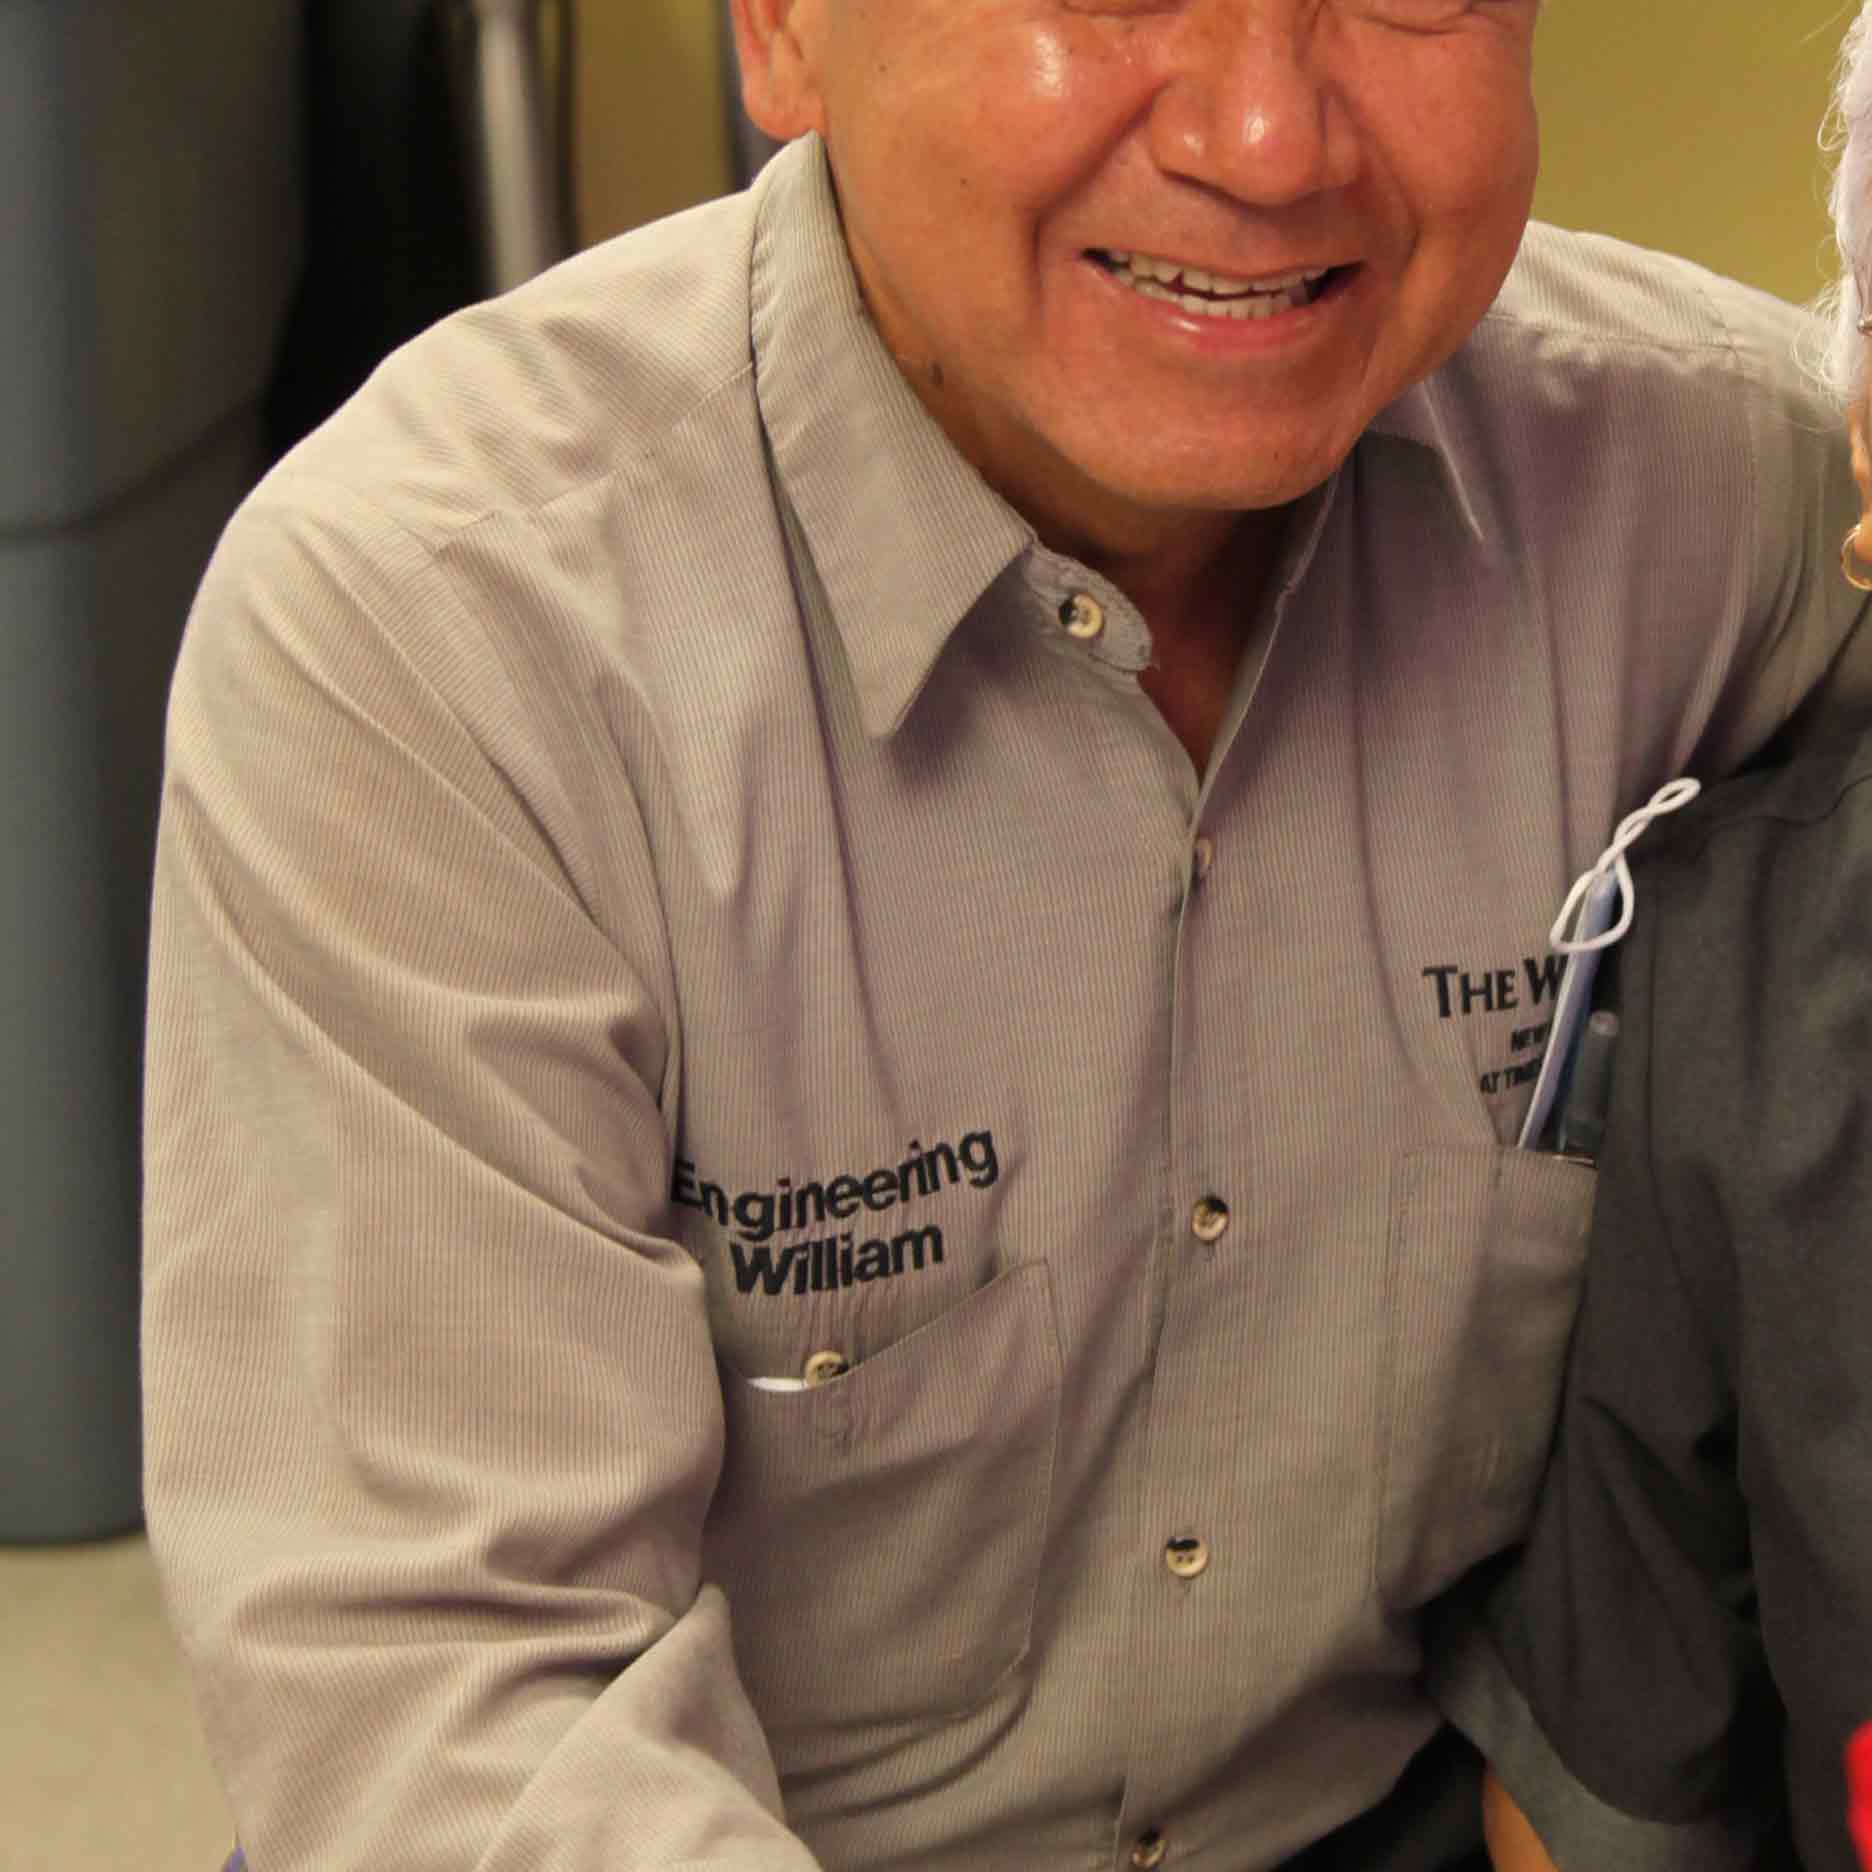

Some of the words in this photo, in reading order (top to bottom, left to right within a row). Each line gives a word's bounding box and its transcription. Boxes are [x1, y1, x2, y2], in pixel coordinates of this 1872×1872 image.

[1422, 964, 1520, 1018] THE
[1523, 954, 1569, 1005] W
[671, 1130, 999, 1242] Engineering
[730, 1224, 944, 1295] William
